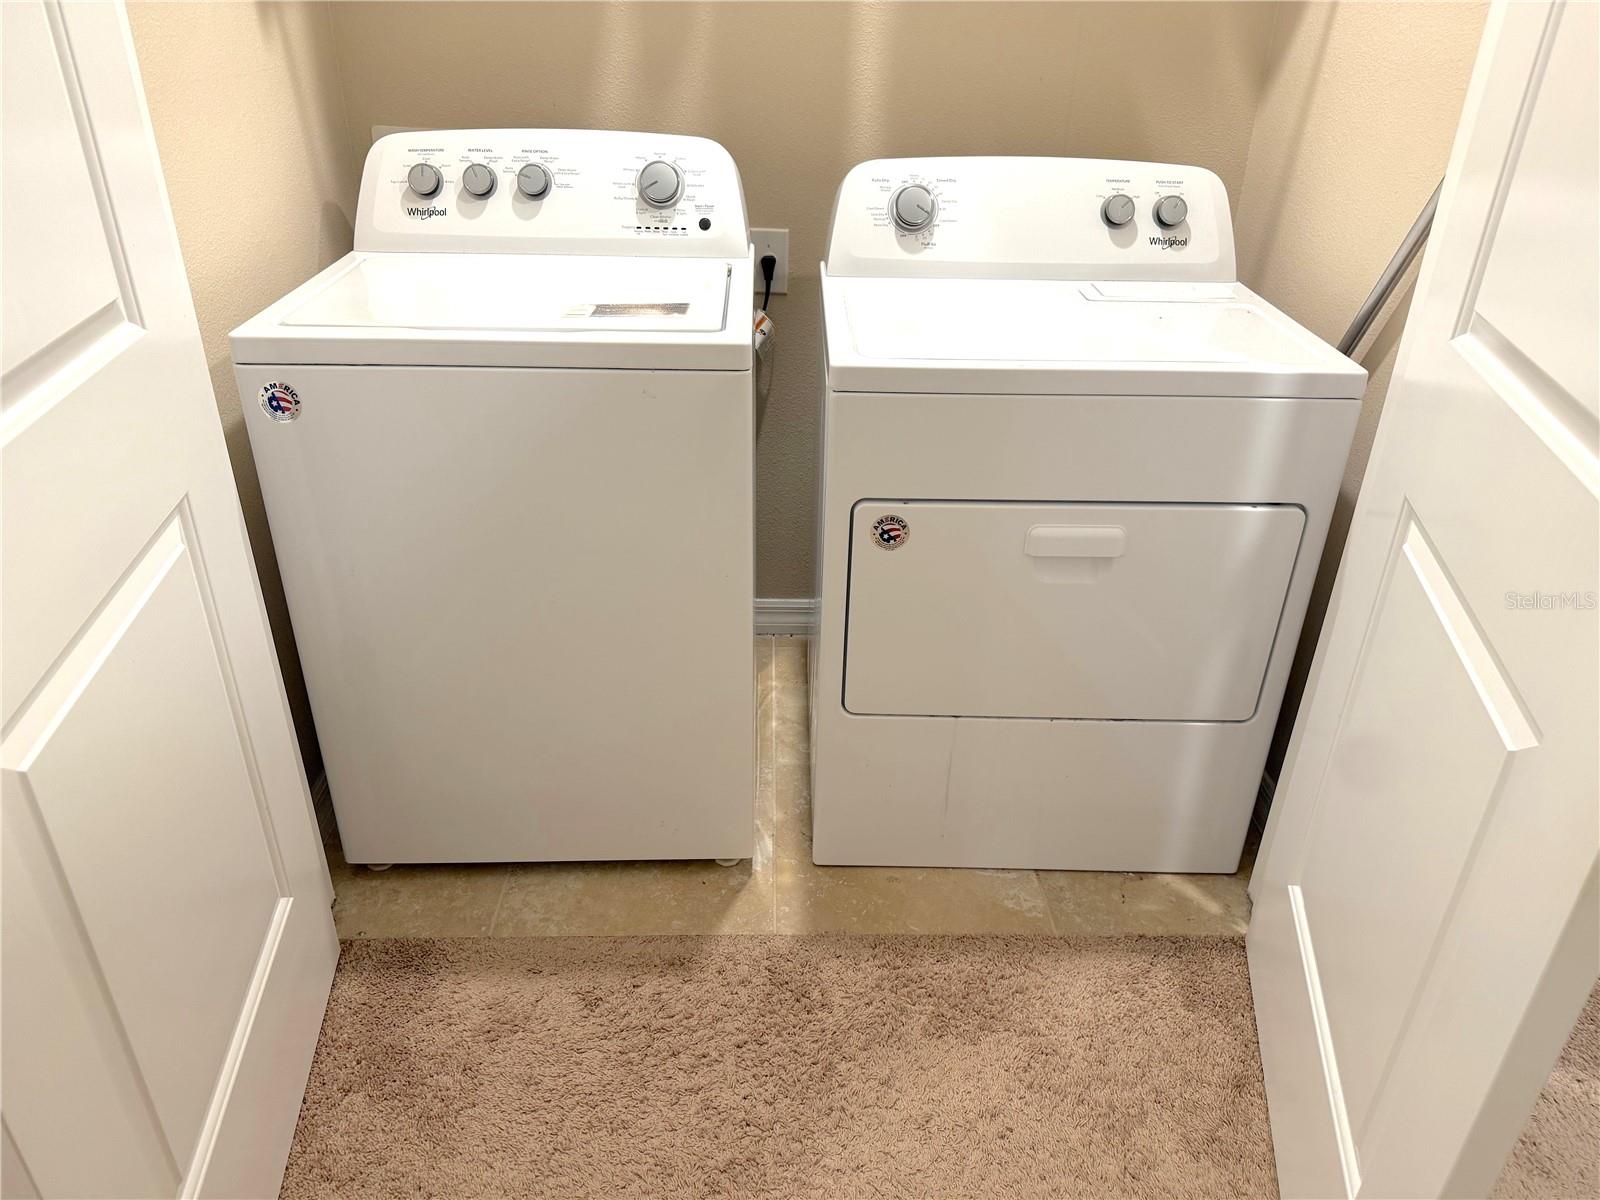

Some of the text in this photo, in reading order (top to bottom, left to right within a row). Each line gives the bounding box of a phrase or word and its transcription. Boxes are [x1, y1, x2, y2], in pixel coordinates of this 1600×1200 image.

[407, 207, 447, 218] Whirlpool
[1149, 237, 1188, 248] Whirlpool
[263, 382, 300, 406] AMERICA
[873, 516, 907, 531] AMERICA
